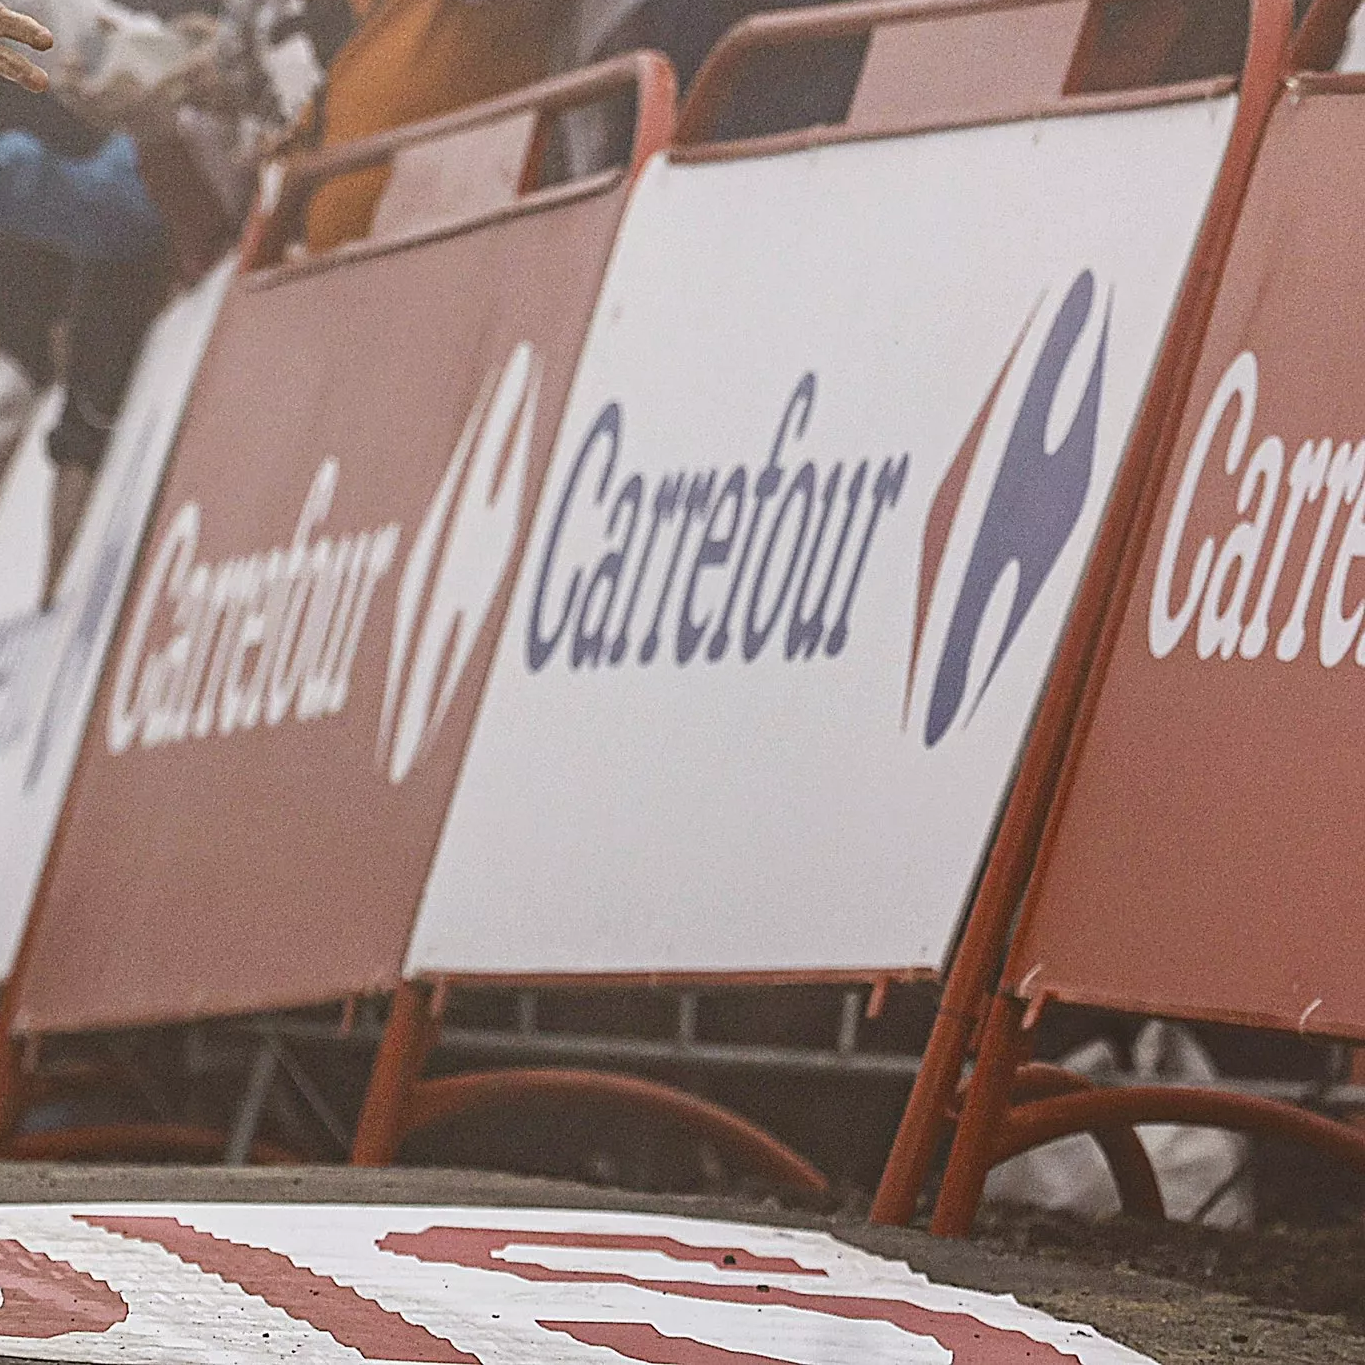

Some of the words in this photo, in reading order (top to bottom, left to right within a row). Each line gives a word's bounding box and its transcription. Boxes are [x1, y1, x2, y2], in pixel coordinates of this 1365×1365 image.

[107, 455, 403, 753] Carrefour
[526, 371, 910, 671] Carrefour
[1147, 350, 1365, 668] Carre
